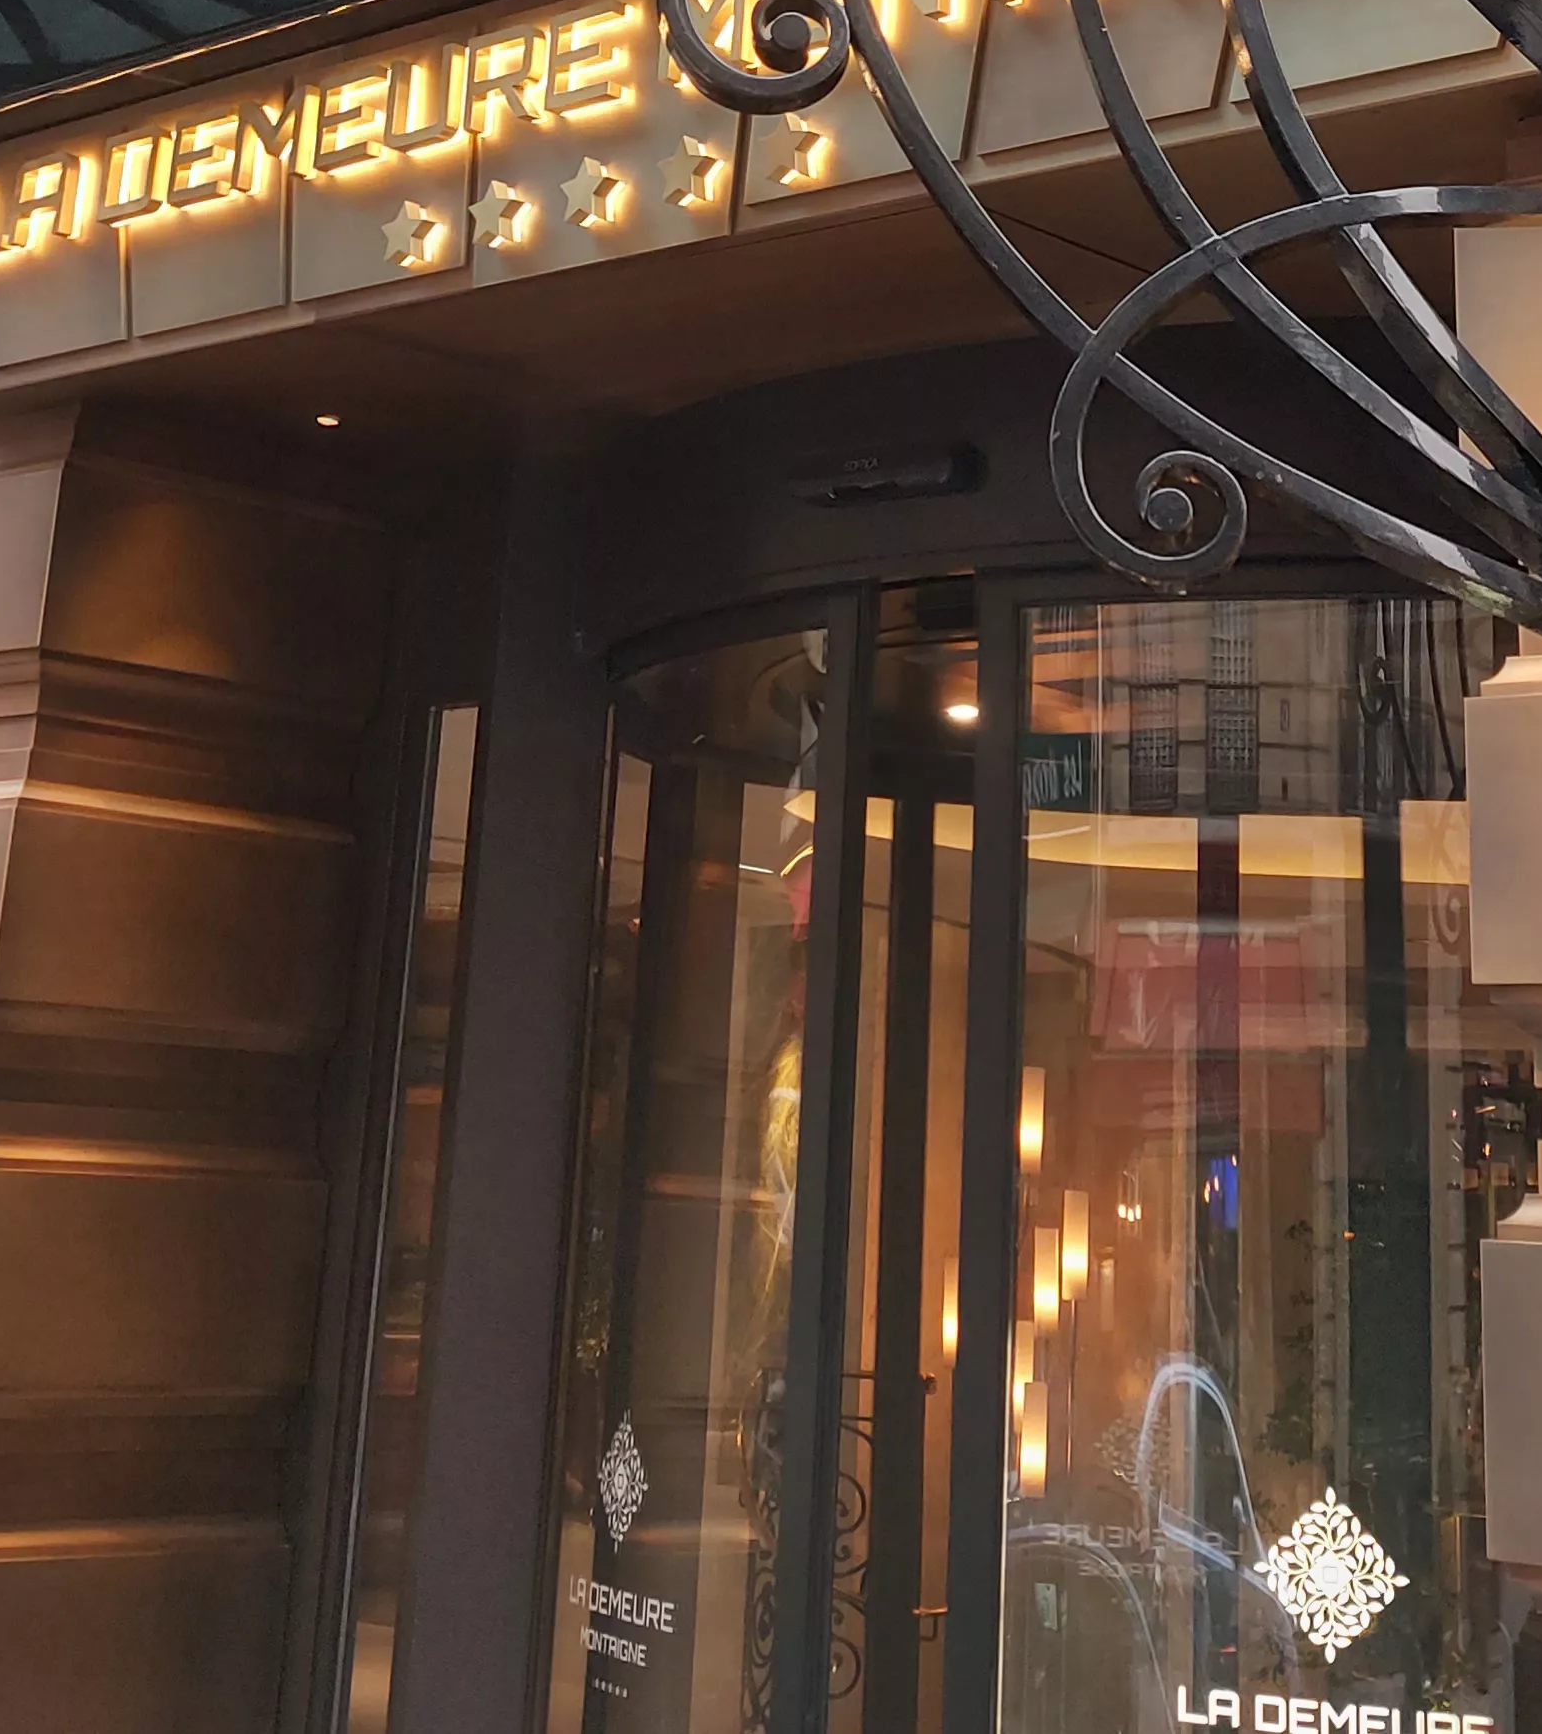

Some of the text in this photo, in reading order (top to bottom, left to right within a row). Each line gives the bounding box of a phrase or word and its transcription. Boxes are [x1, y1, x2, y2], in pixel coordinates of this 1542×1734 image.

[97, 0, 639, 227] DEMEURE
[568, 1573, 676, 1634] LA DEMEURE
[579, 1624, 648, 1667] MONTAIGNE
[1177, 1684, 1241, 1729] LA
